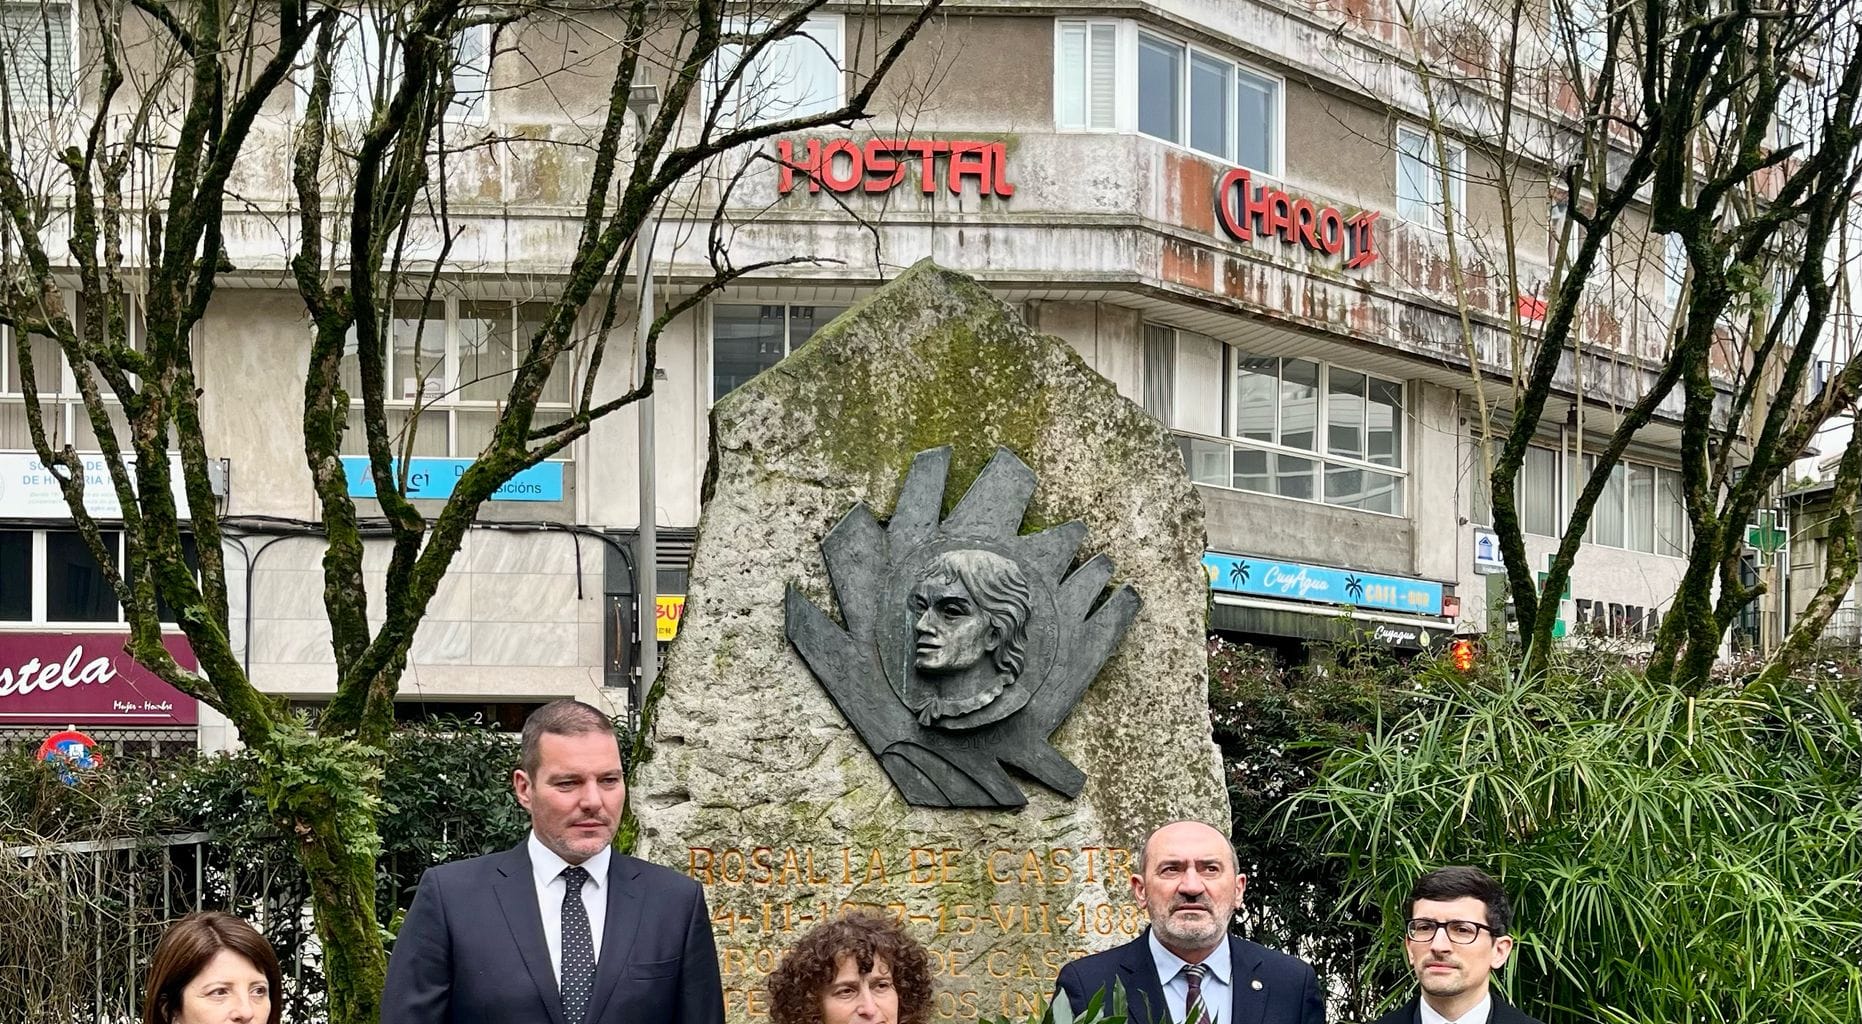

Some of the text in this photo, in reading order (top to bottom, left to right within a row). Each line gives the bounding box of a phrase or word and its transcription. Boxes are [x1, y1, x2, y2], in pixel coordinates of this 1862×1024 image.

[777, 138, 1015, 199] HOSTAL
[1216, 168, 1344, 255] CHARO
[113, 700, 137, 713] Mujer
[474, 711, 483, 725] 2
[689, 847, 888, 885] ROSALIA
[909, 848, 963, 884] DE
